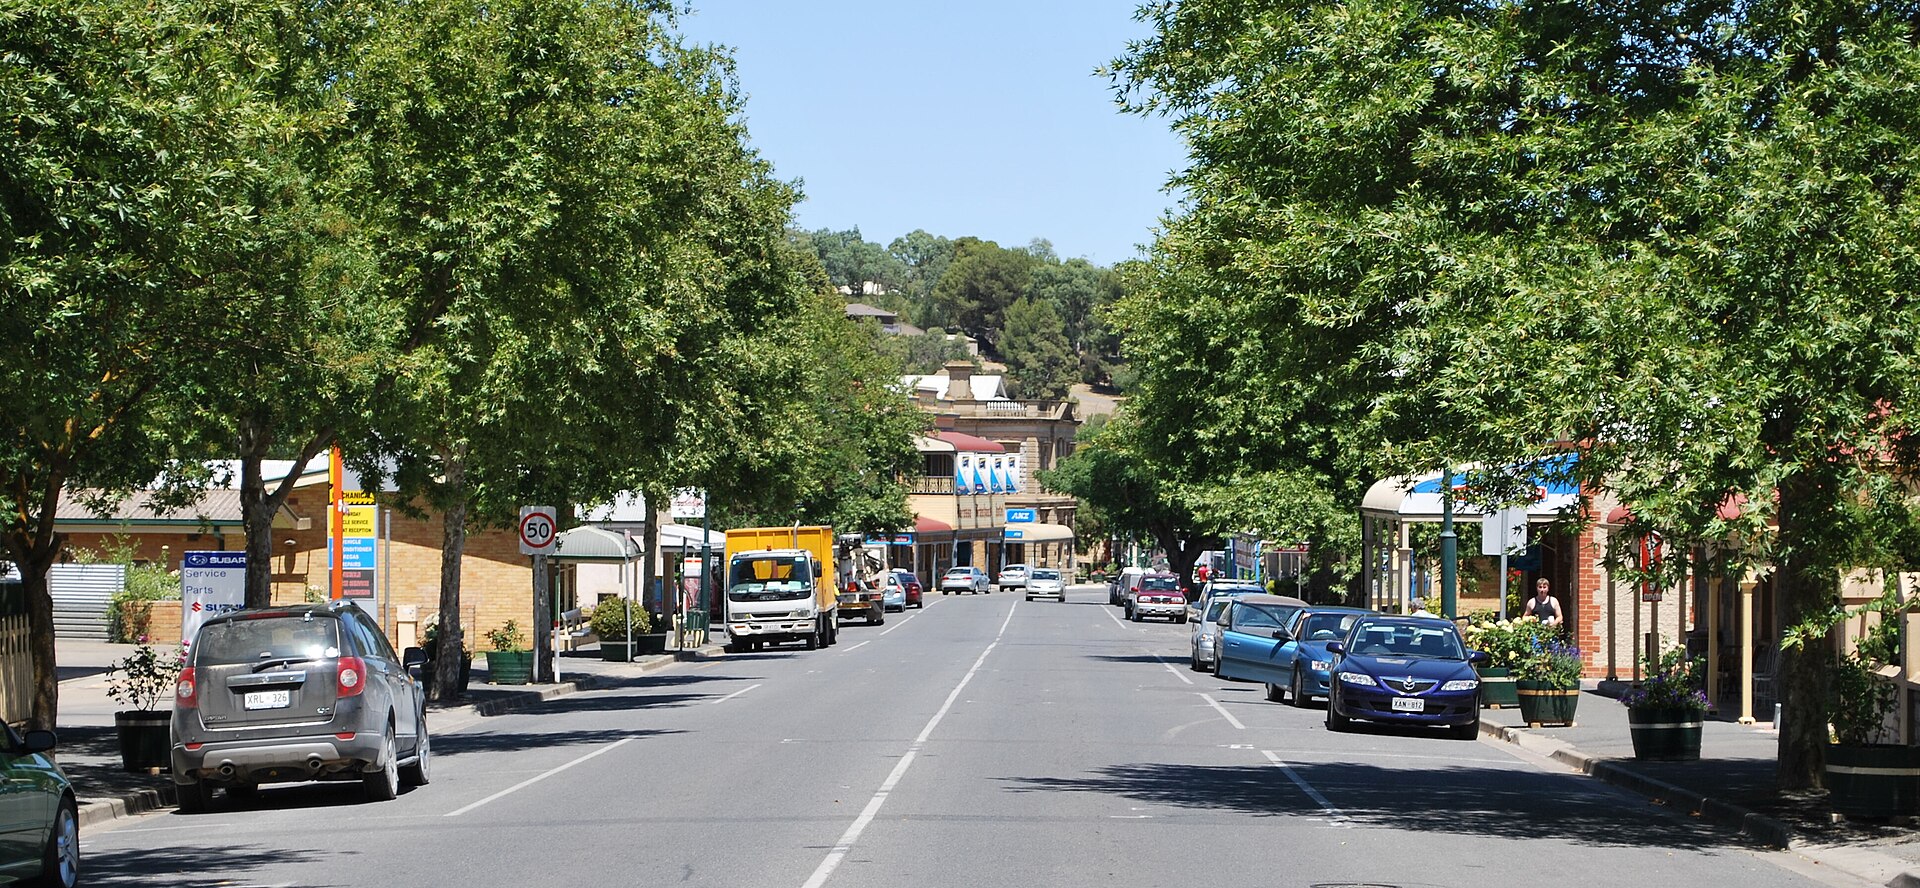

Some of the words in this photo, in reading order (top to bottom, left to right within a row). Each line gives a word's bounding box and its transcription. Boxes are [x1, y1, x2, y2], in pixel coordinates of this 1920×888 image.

[1011, 512, 1030, 520] ANZ
[527, 522, 549, 538] 50
[209, 556, 247, 564] SUBAR
[185, 569, 227, 578] Service
[185, 585, 214, 594] Parts
[247, 694, 265, 704] XRL
[272, 693, 287, 703] 326
